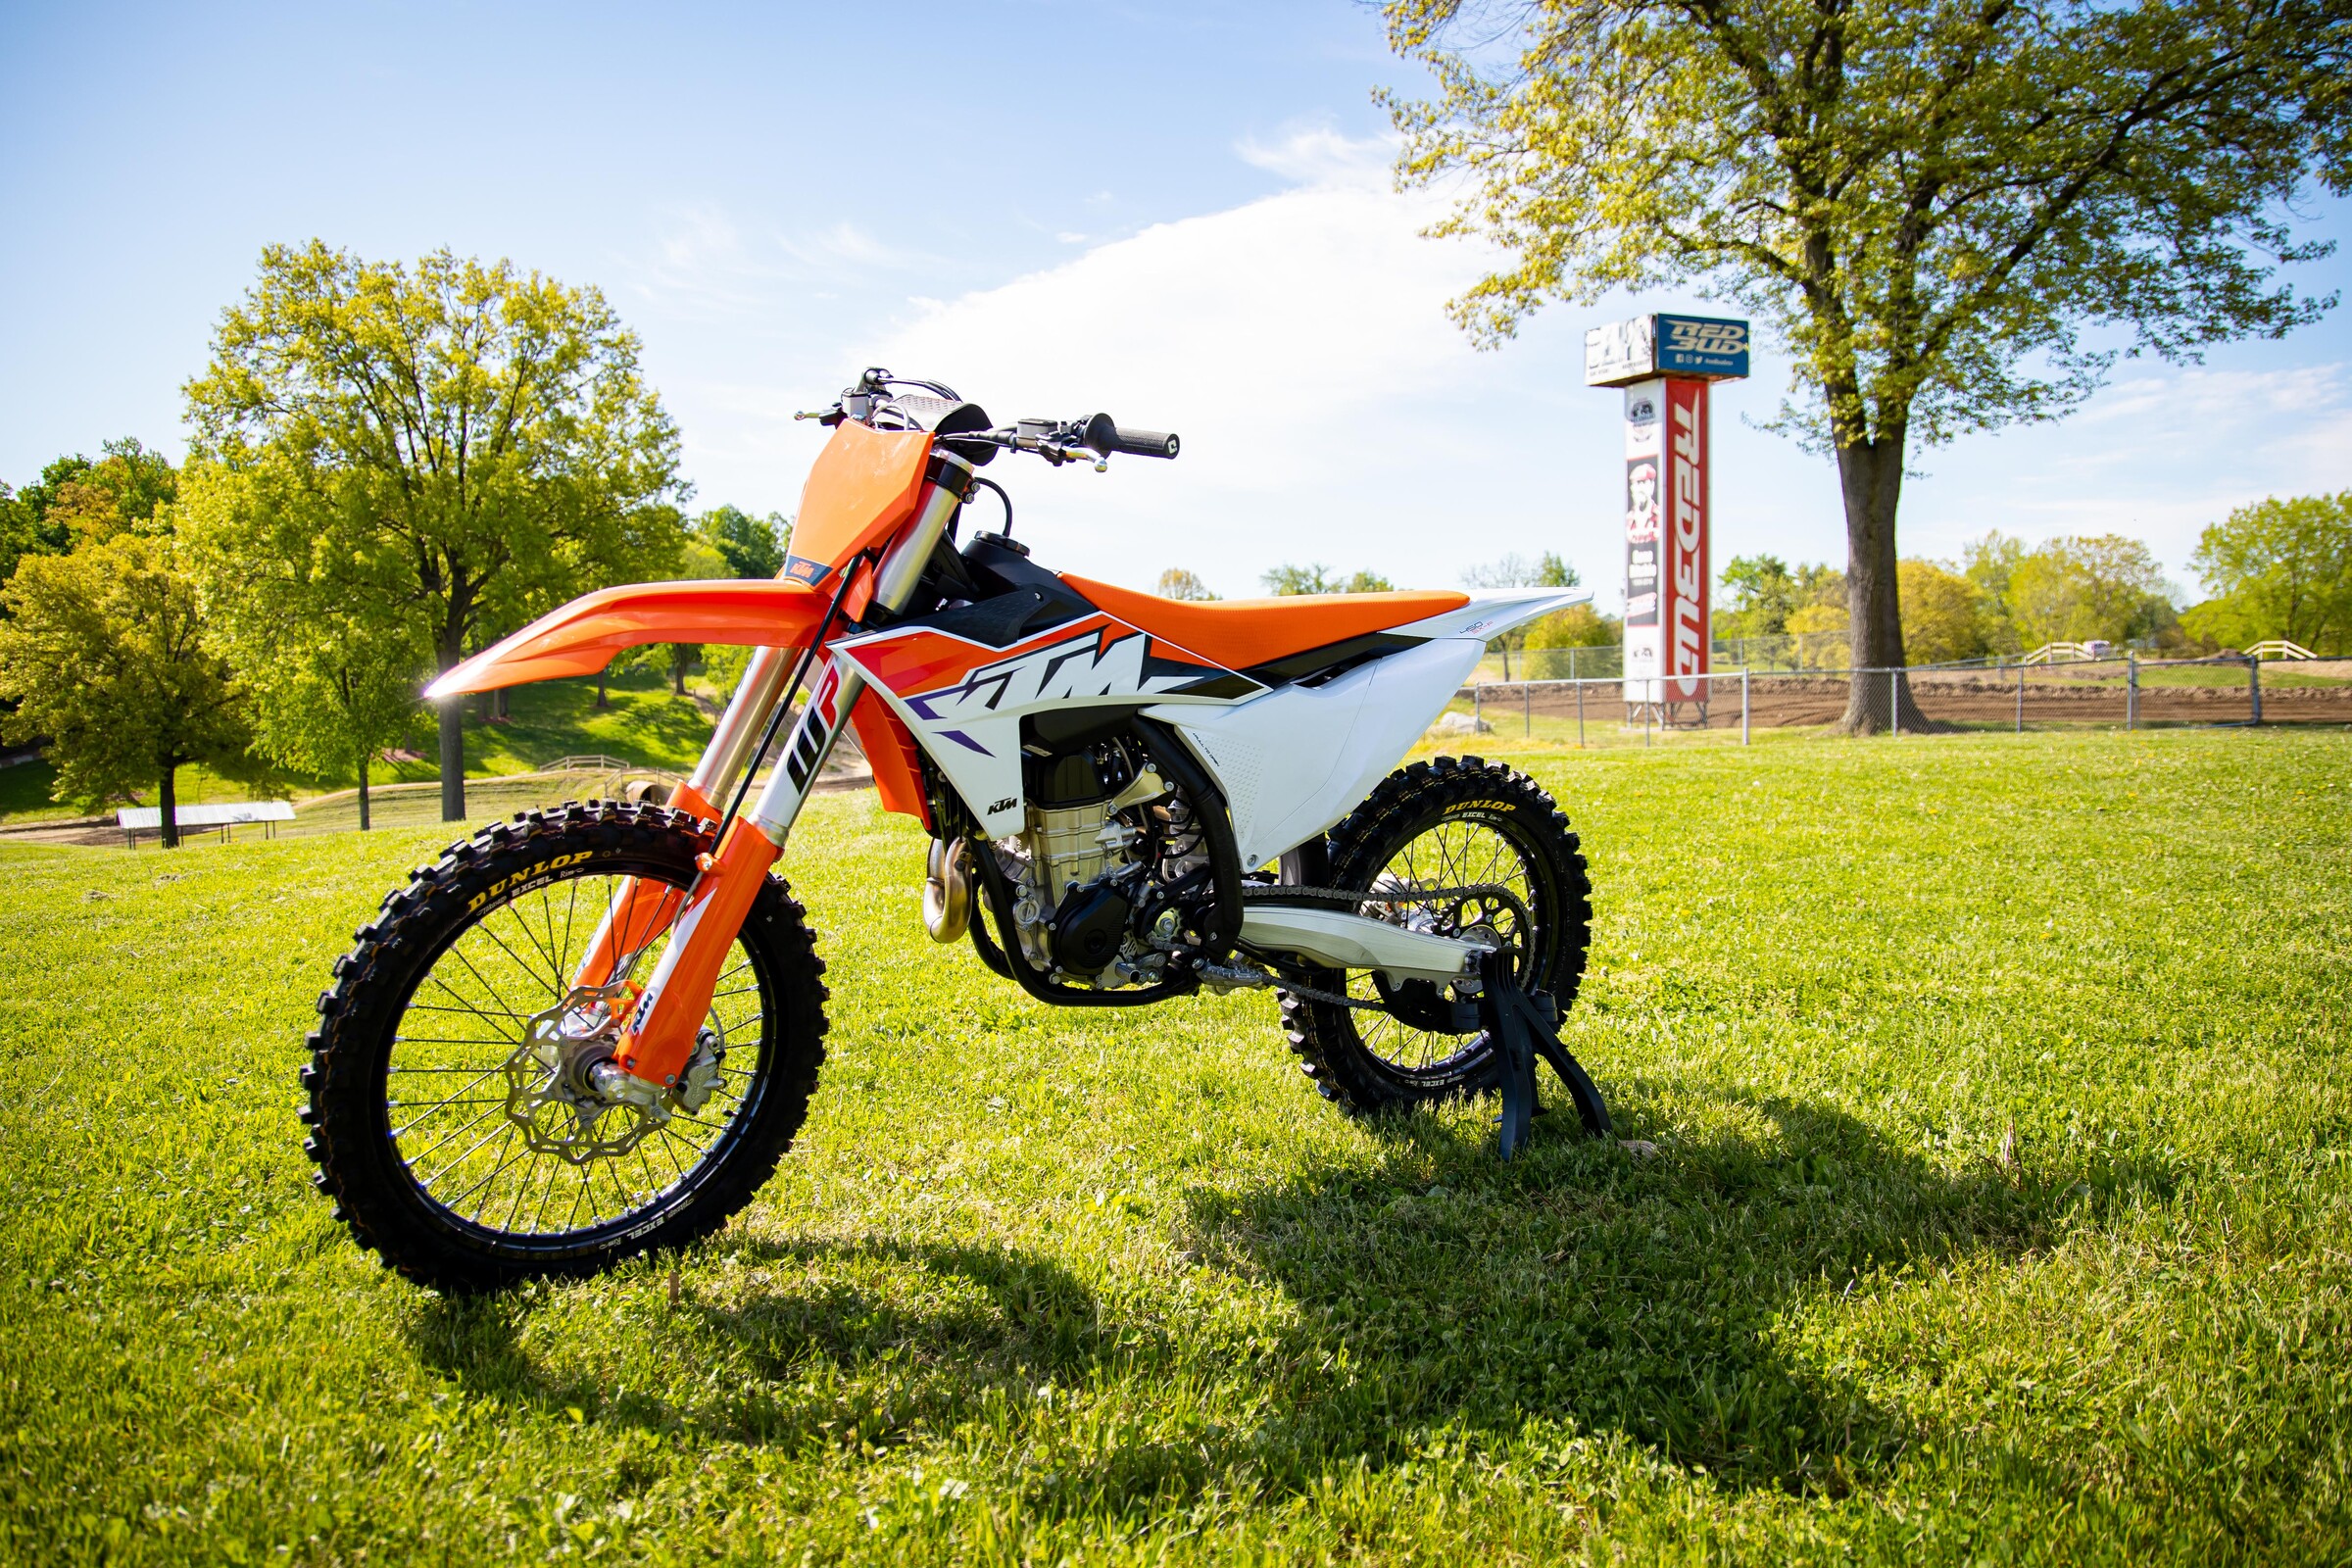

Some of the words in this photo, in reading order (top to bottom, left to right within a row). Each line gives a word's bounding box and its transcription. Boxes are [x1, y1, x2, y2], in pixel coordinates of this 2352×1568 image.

[1665, 318, 1745, 340] RED
[1665, 335, 1749, 355] BUD
[789, 561, 815, 578] KTM
[904, 623, 1171, 743] KTM
[987, 797, 1017, 815] KTM
[1443, 800, 1516, 815] DUNLOP
[467, 851, 593, 912] DUNLOP
[511, 875, 554, 898] EXCEL
[626, 1216, 665, 1241] EXCEL
